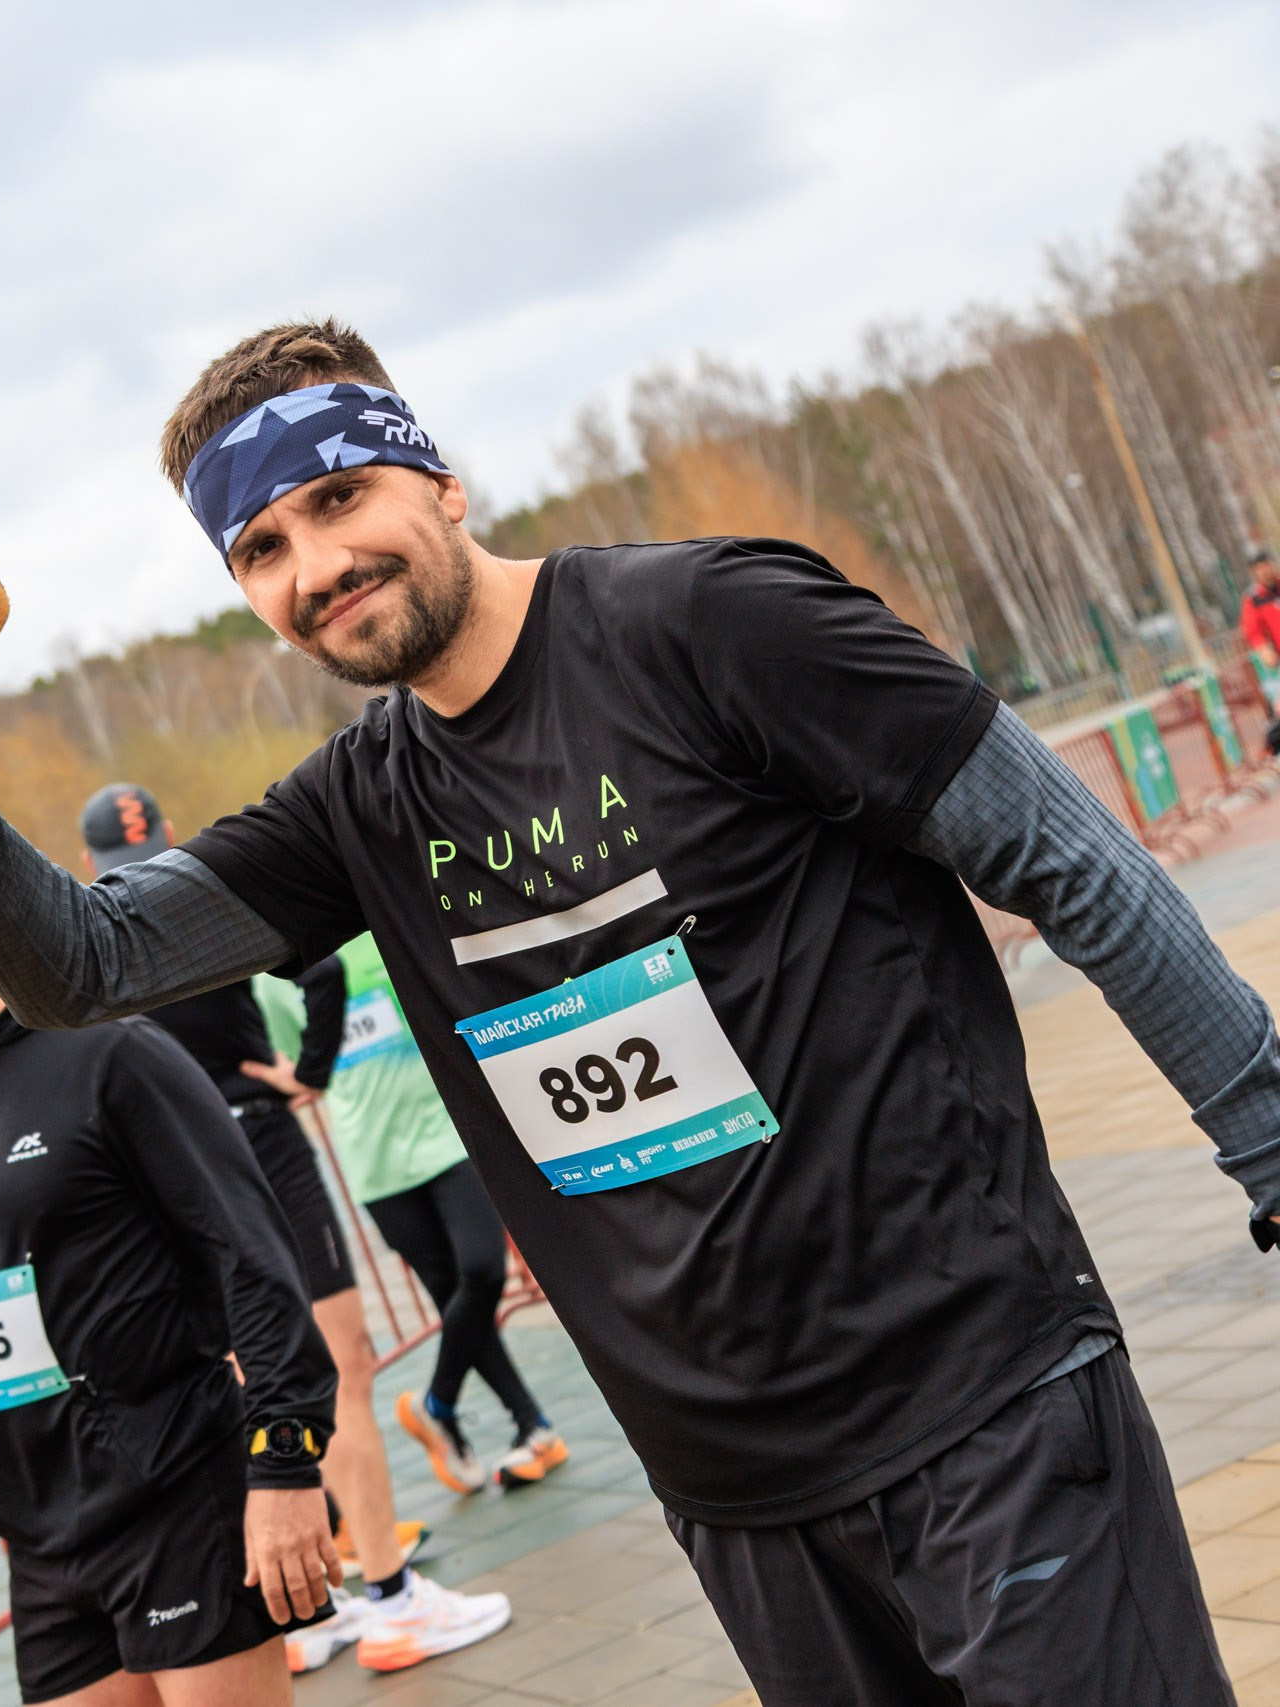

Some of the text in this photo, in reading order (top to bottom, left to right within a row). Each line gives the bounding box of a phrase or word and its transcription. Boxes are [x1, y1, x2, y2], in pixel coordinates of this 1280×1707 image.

[428, 774, 627, 879] PUMA
[440, 826, 639, 911] ON HE RUN
[345, 1015, 377, 1042] 19
[472, 994, 587, 1045] МАЙСКАЯ ГРОЗА
[538, 1037, 679, 1124] 892
[562, 1173, 572, 1181] 10
